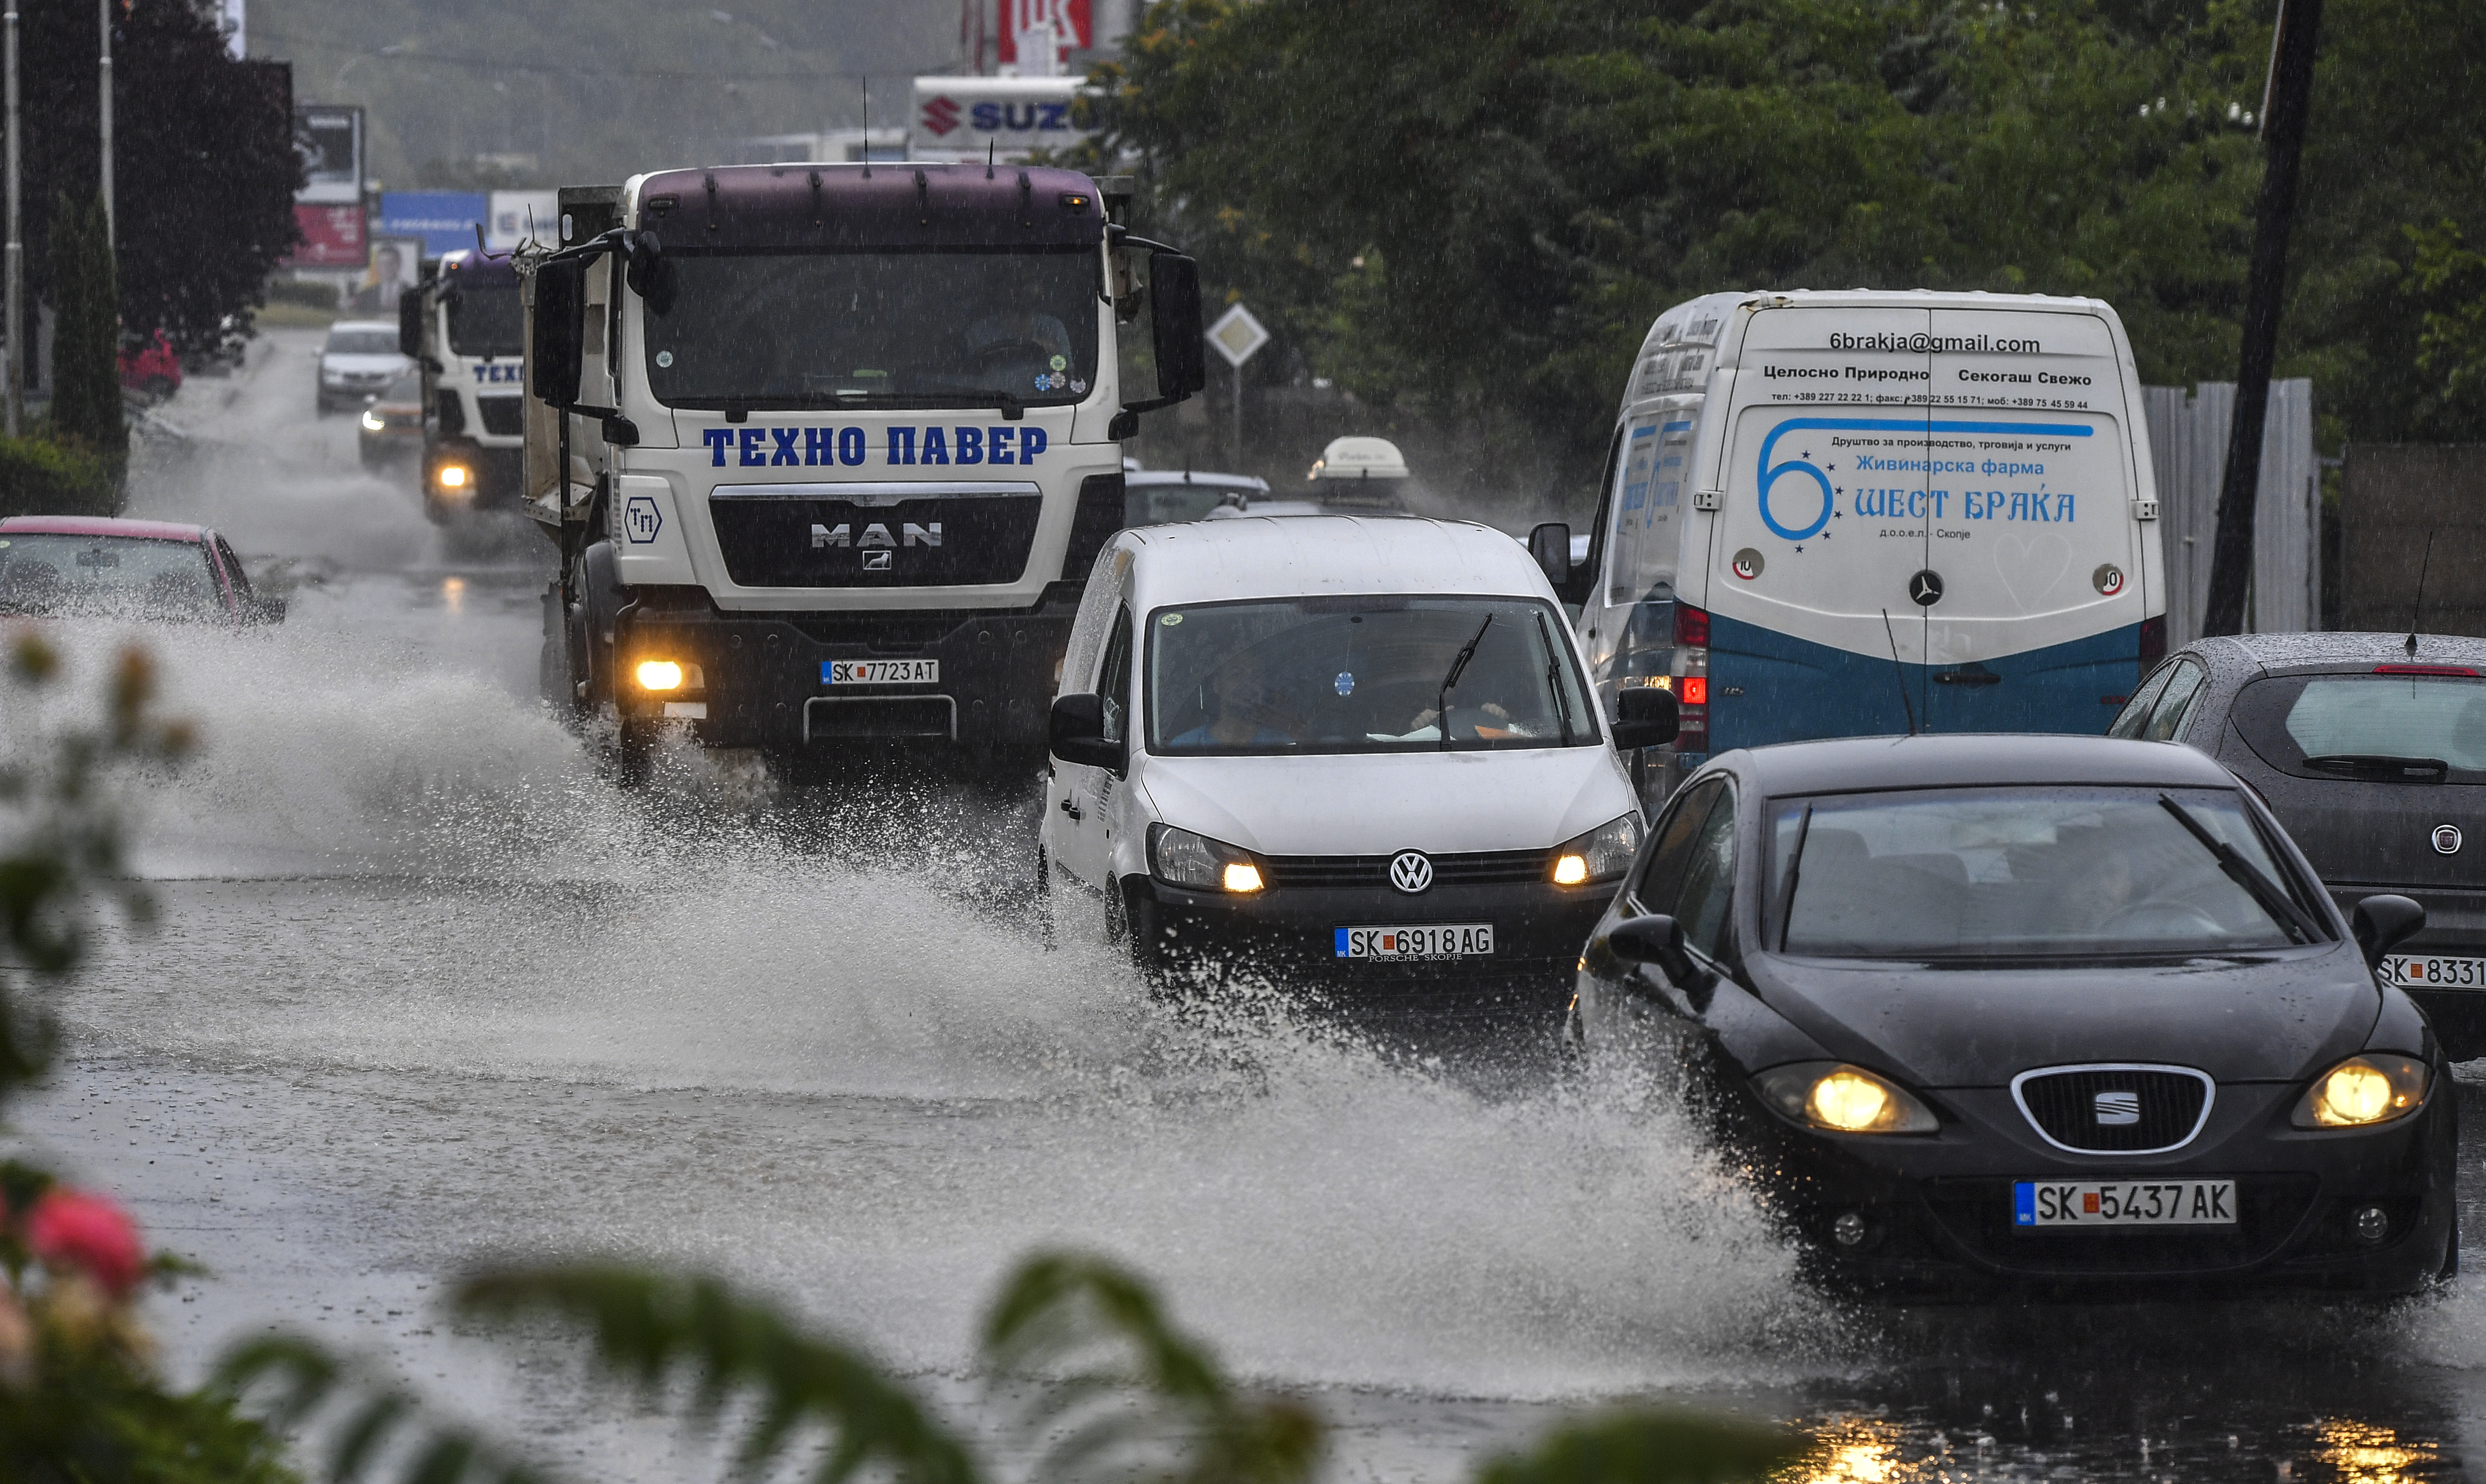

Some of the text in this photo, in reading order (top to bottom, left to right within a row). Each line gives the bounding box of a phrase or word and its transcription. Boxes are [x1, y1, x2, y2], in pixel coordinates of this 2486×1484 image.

[1830, 332, 2040, 353] 6brakja@gmail.com
[1764, 365, 1930, 381] Целосно Природно
[1958, 369, 2092, 386] Секогаш Свежо
[1876, 394, 1903, 404] факс:
[1987, 397, 2009, 406] моб:
[2012, 398, 2033, 406] +389
[2037, 399, 2047, 407] 75
[2051, 400, 2062, 408] 45
[2065, 400, 2075, 409] 59
[2078, 401, 2088, 409] 44
[703, 426, 1048, 468] ТЕХНО ПАВЕР
[1832, 437, 1880, 447] Друштво
[1897, 439, 1975, 449] производство,
[1979, 440, 2023, 451] трговија
[2036, 442, 2071, 452] услуги
[1856, 456, 2044, 477] Живинарска фарма
[1854, 488, 1949, 519] ШЕСТ
[811, 523, 942, 547] MAN
[1937, 529, 1970, 540] Скопје
[833, 662, 935, 681] SK 7723 AT
[1351, 928, 1489, 956] SK 6918 AG
[2379, 958, 2409, 983] SK
[2427, 959, 2485, 985] 8331
[2039, 1186, 2078, 1220] SK
[2100, 1185, 2184, 1219] 5437
[2191, 1184, 2230, 1219] AK
